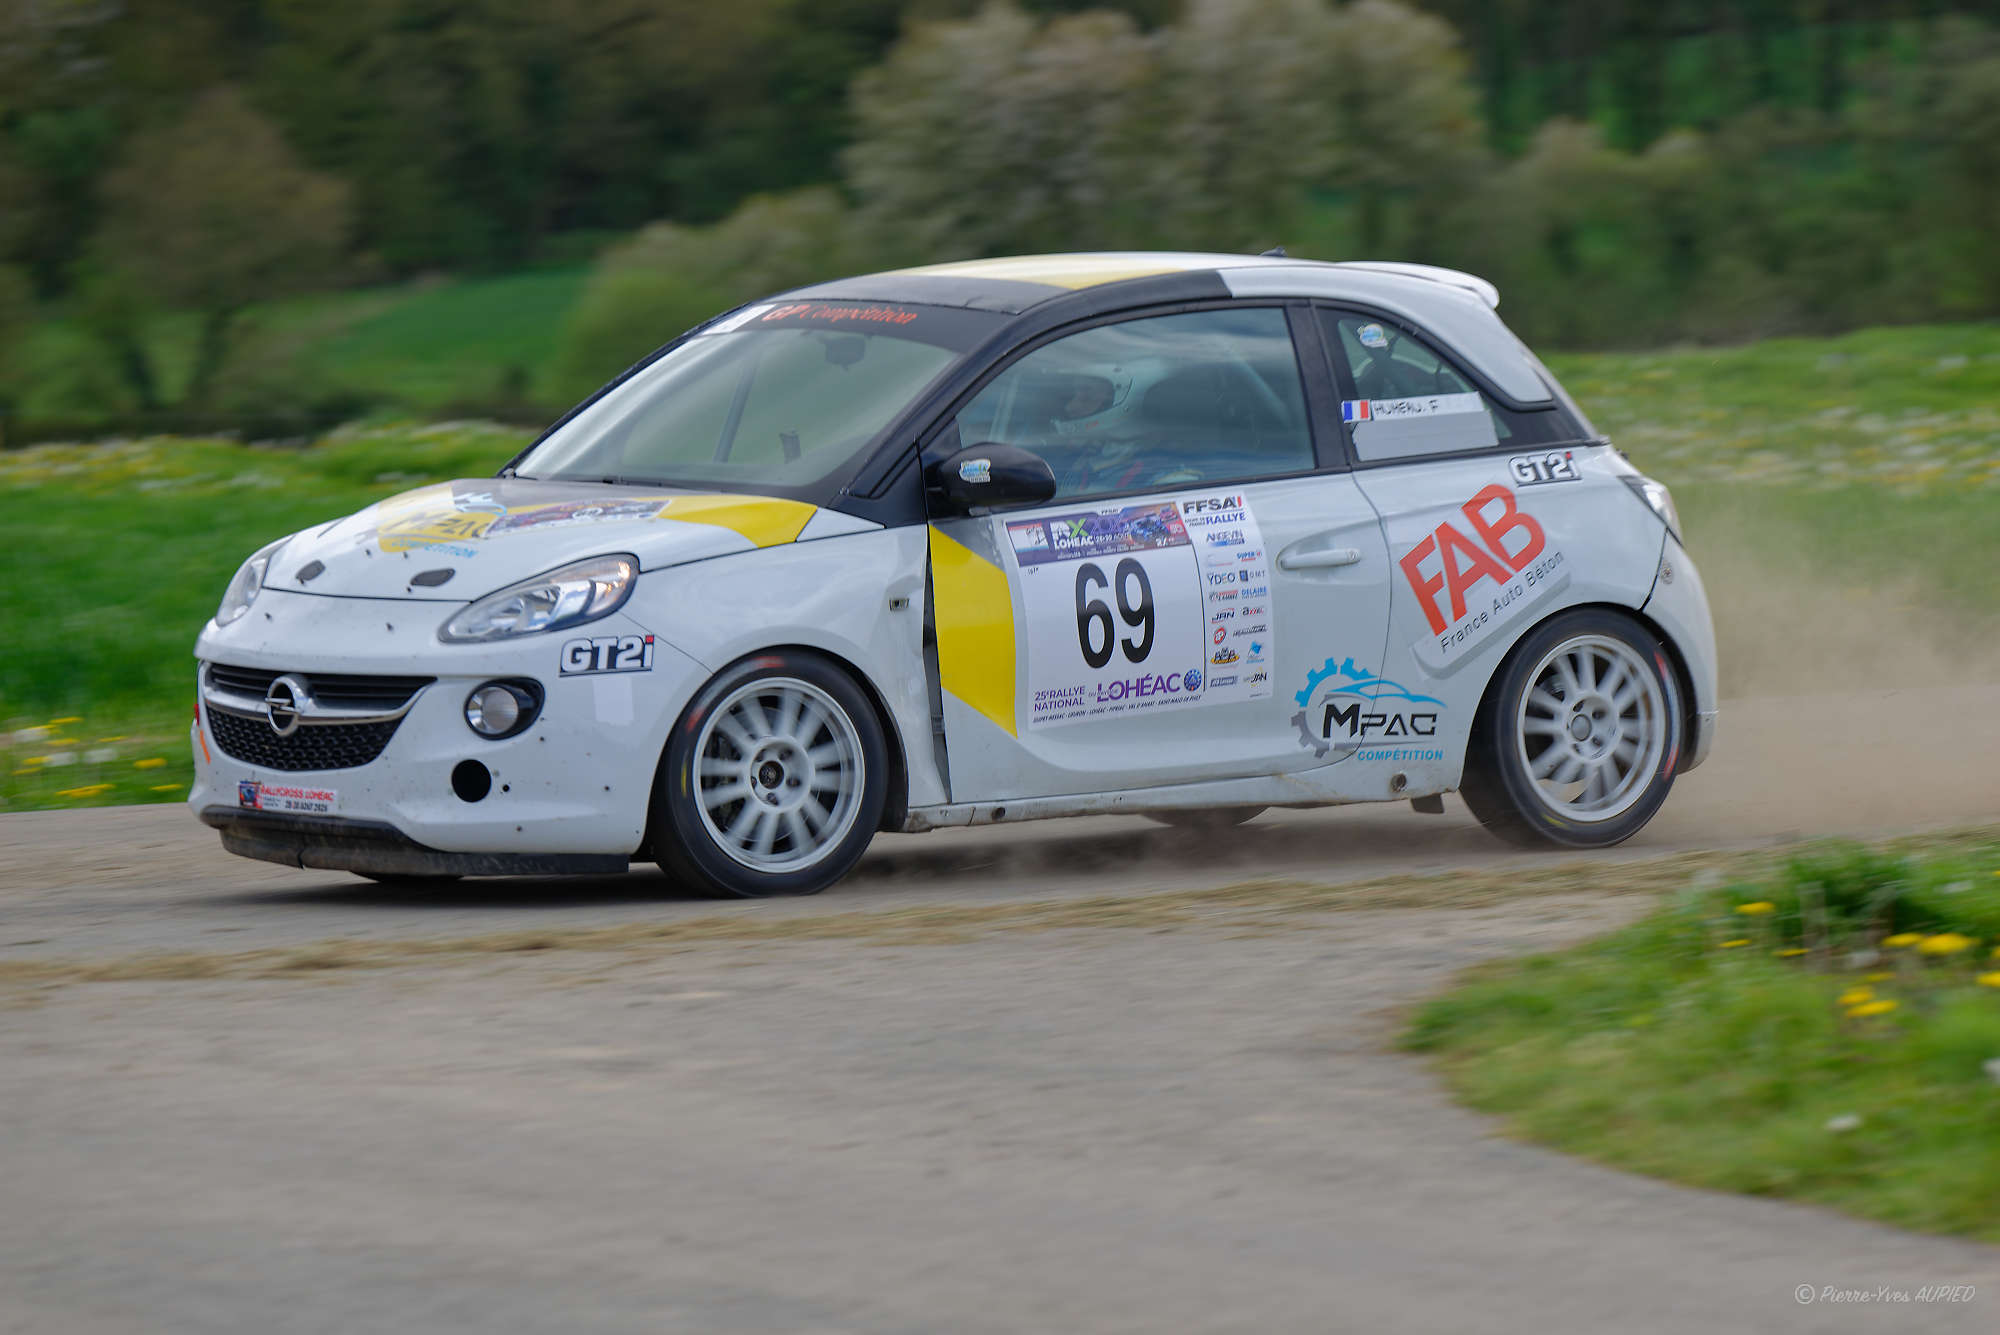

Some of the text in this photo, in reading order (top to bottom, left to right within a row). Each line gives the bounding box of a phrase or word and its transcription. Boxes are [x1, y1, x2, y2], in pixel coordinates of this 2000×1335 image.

[1509, 451, 1577, 484] GT2i
[1205, 512, 1246, 525] RALLYE
[1399, 483, 1547, 637] FAB
[1075, 557, 1155, 669] 69
[1440, 612, 1489, 653] France
[1492, 584, 1524, 615] Auto
[560, 634, 654, 674] GT2i
[1050, 686, 1085, 700] RALLYE
[1097, 673, 1181, 702] LOHÉAC
[1034, 698, 1085, 712] NATIONAL
[1323, 703, 1437, 738] MPAC
